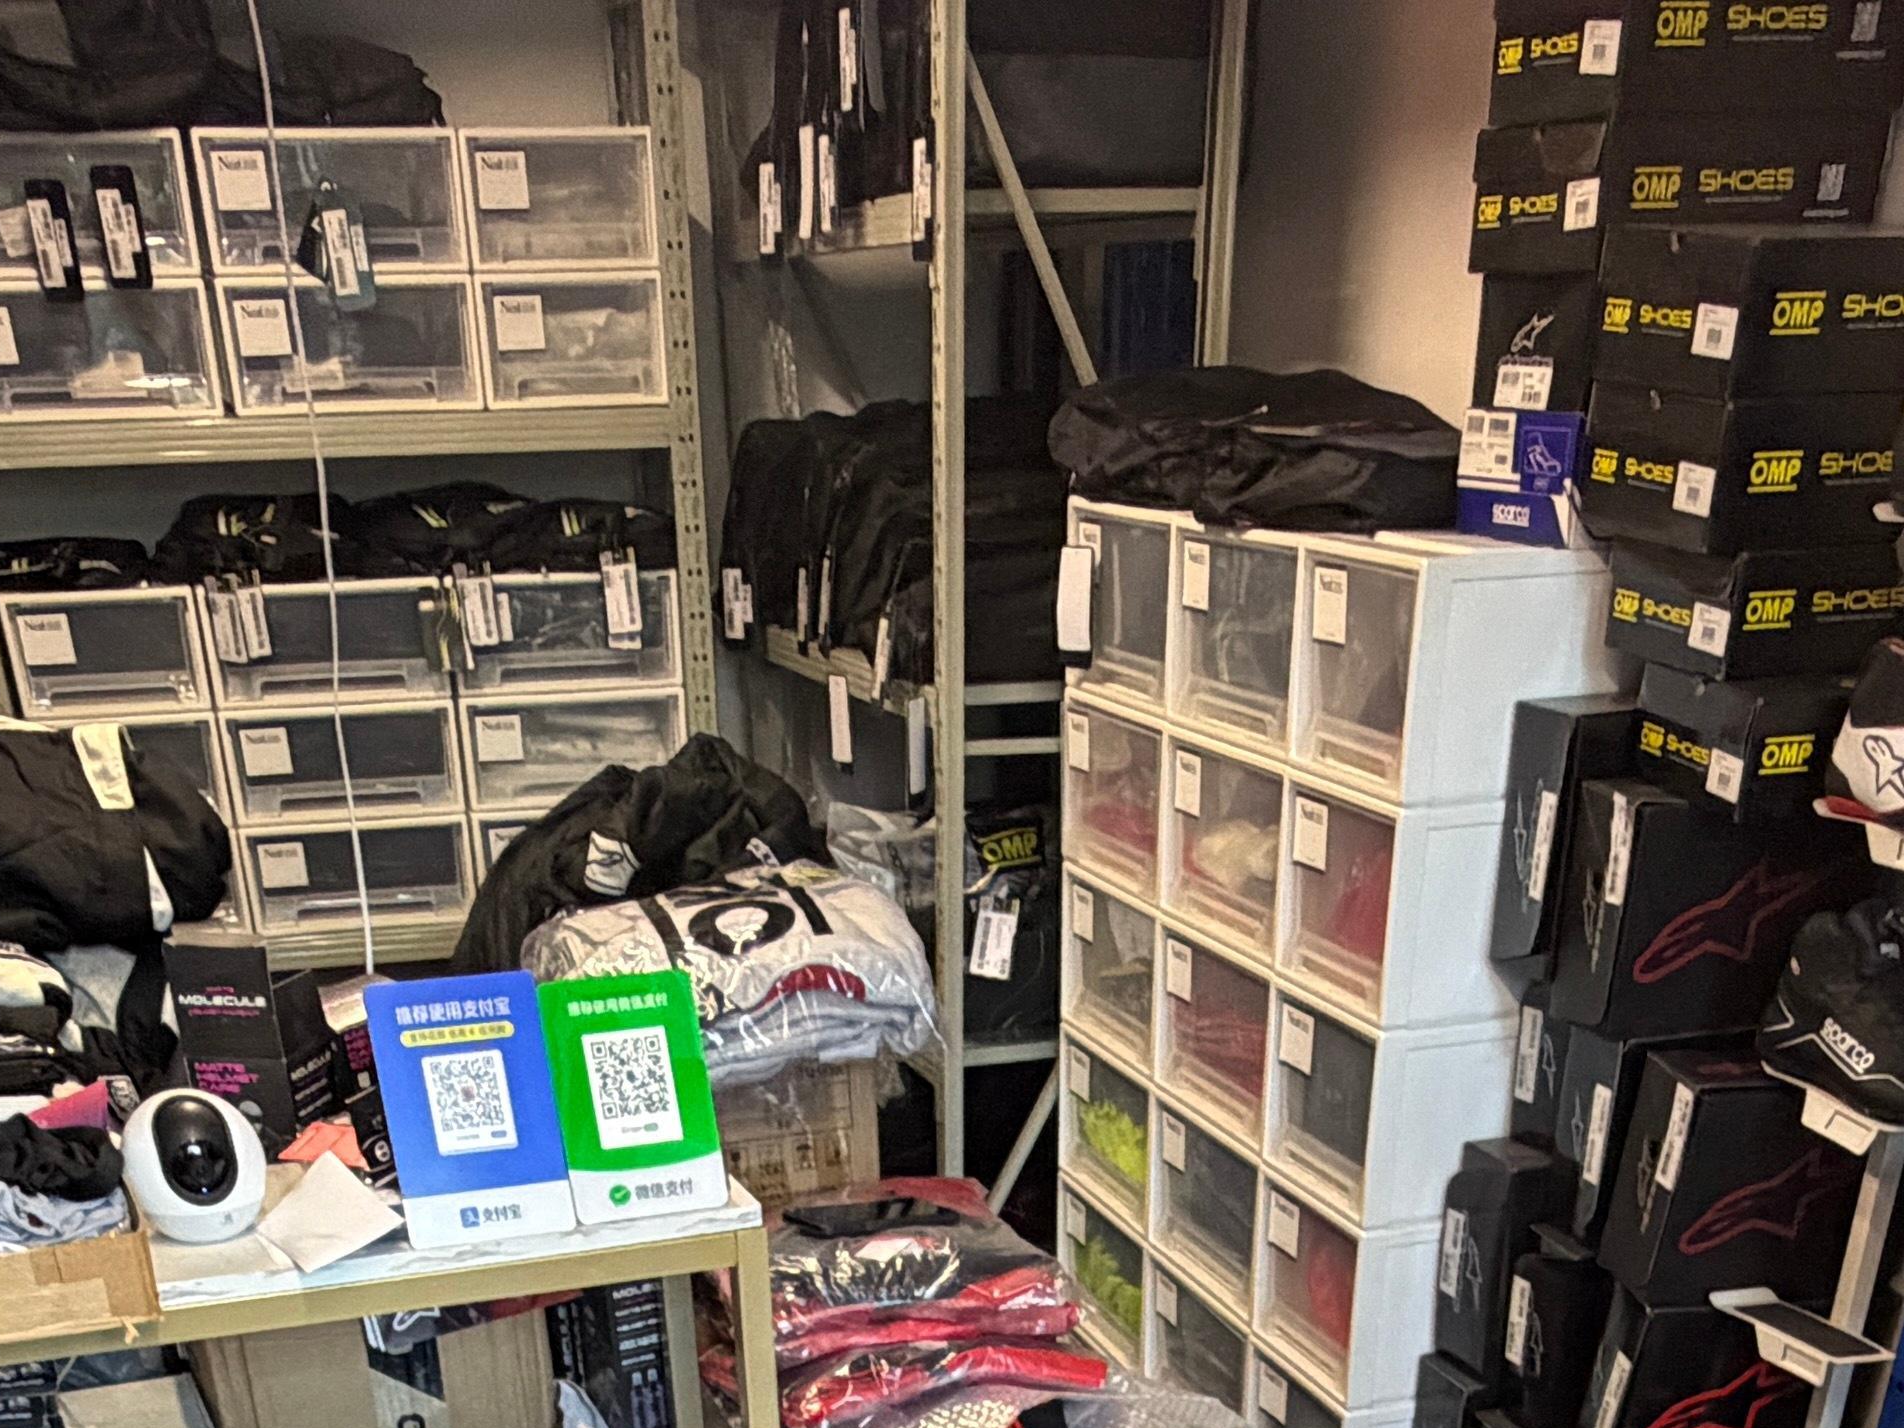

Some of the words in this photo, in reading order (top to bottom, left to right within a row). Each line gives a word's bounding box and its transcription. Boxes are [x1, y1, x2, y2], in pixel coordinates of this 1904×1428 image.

[1656, 8, 1709, 38] OMP
[1727, 4, 1828, 30] SHOES
[1632, 173, 1683, 200] OMP
[1698, 167, 1794, 193] SHOES
[1603, 303, 1633, 327] OMP
[1639, 304, 1693, 330] SHOES
[1772, 299, 1826, 328] OMP
[1625, 457, 1674, 485] SHOES
[1749, 458, 1802, 485] OMP
[1819, 451, 1894, 476] SHOE
[1643, 598, 1691, 627] SHOES
[1746, 597, 1795, 623] OMP
[1760, 742, 1814, 768] OMP
[982, 835, 1039, 866] OMP
[177, 993, 268, 1007] MOLECULE
[1819, 1016, 1876, 1069] sparco
[633, 1178, 694, 1201] 微信支付
[481, 1203, 523, 1225] 支付宝
